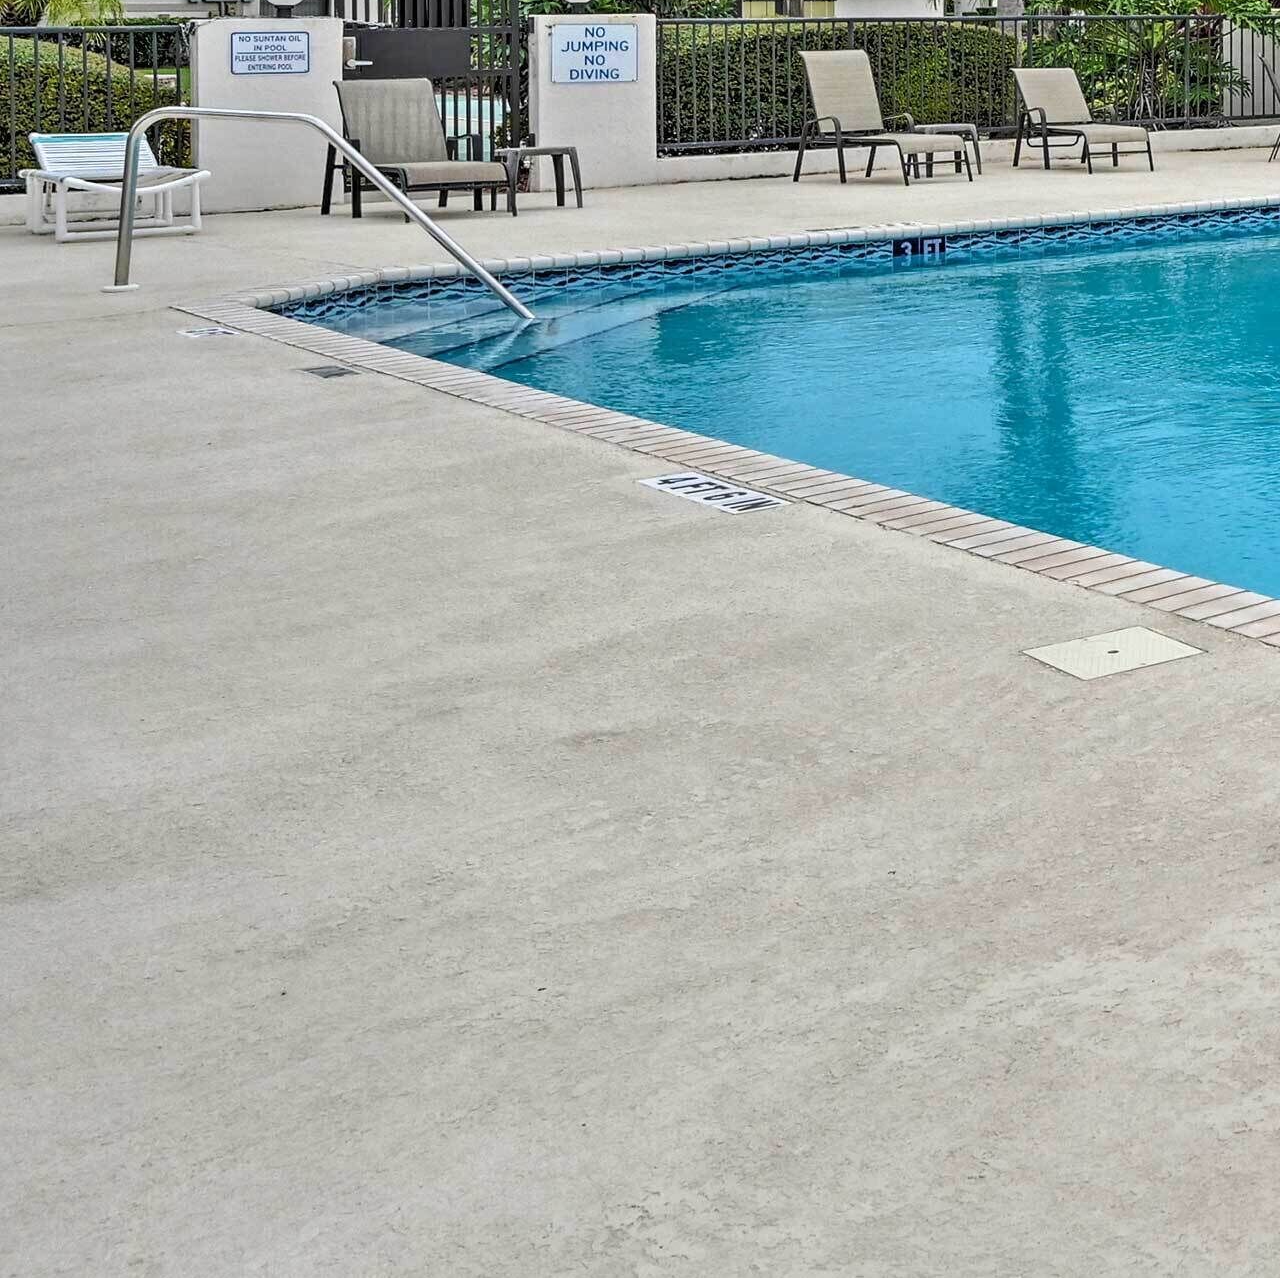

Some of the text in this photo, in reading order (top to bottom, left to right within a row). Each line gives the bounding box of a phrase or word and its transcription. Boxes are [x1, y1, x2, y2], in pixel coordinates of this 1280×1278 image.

[584, 27, 606, 38] NO
[561, 40, 630, 53] JUMPING
[235, 54, 257, 62] PLEASE
[584, 54, 606, 66] NO
[247, 63, 293, 71] ENTERING POOL
[569, 68, 620, 80] DIVING
[923, 238, 942, 256] FT
[657, 476, 782, 512] 4 FT 6 IN
